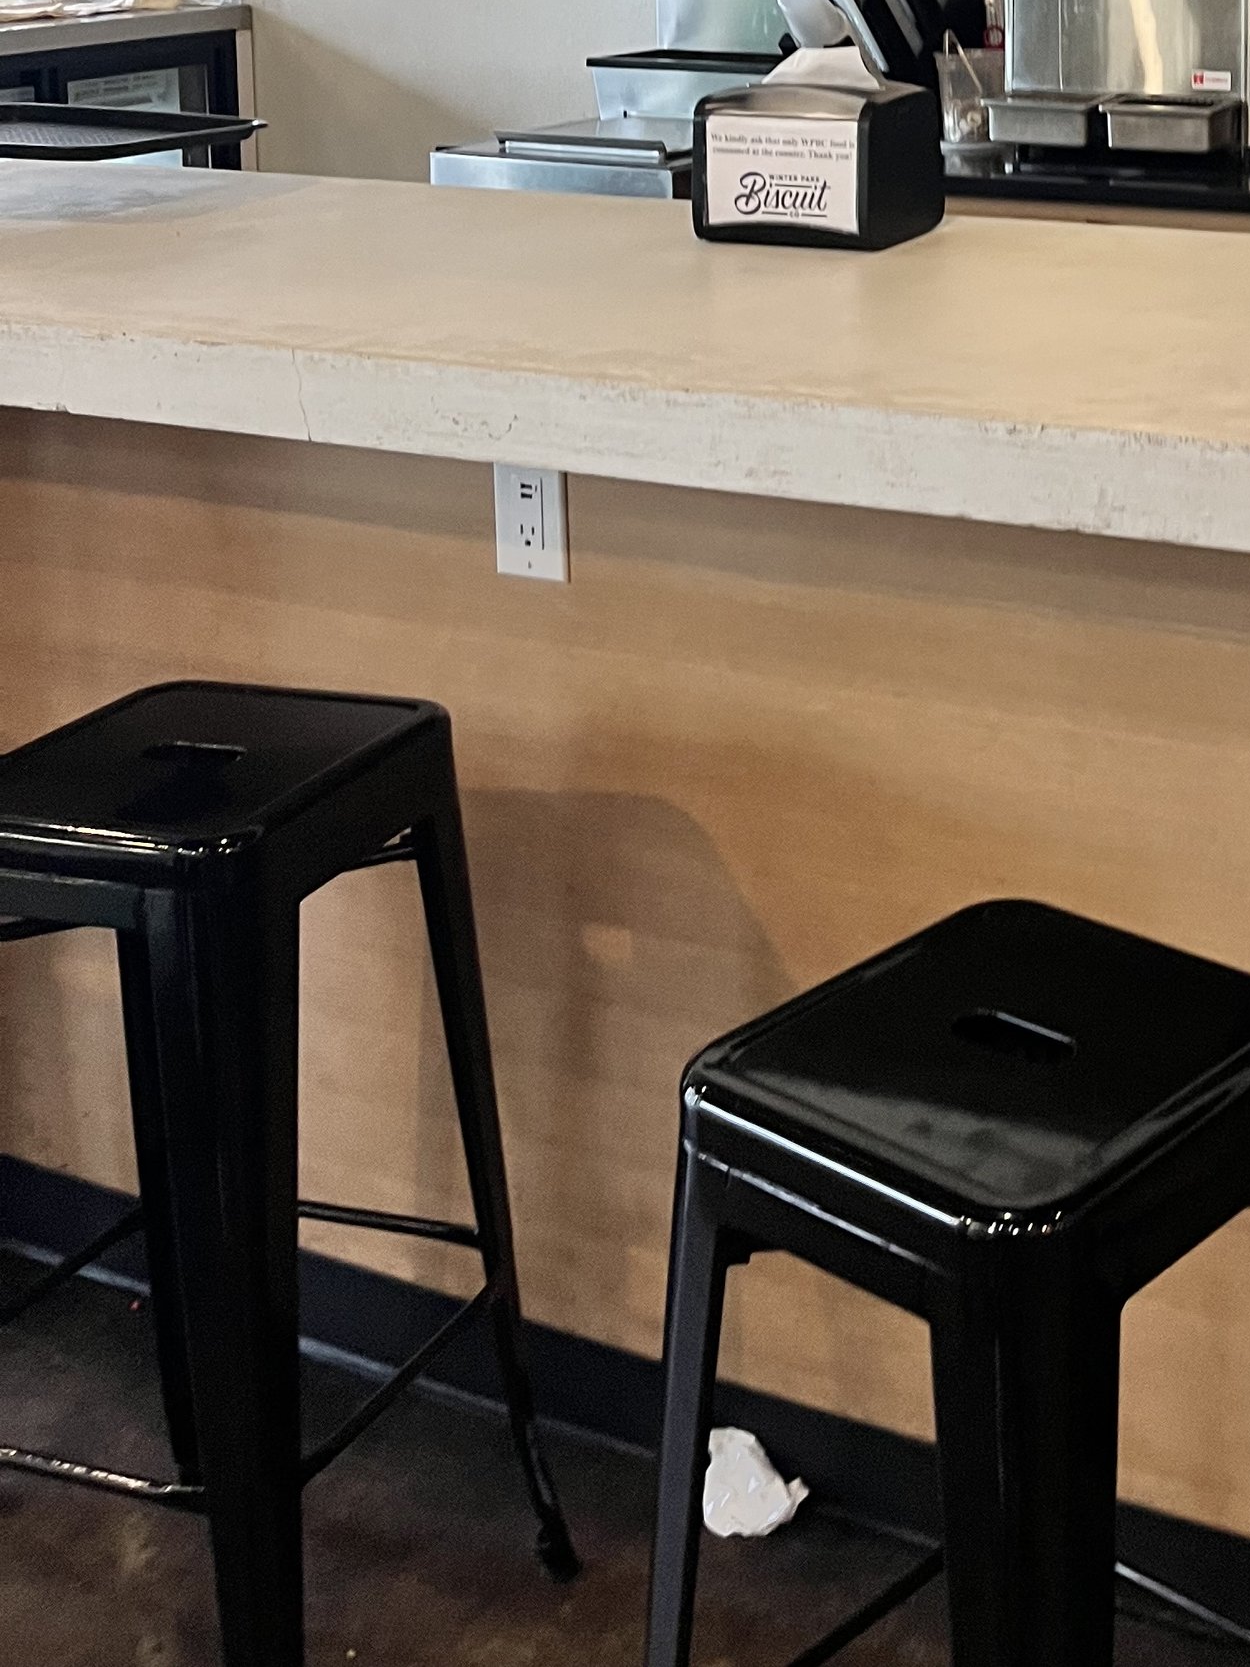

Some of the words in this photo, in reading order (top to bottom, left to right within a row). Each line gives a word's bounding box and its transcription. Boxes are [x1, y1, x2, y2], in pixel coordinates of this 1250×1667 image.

[725, 134, 748, 146] kindly
[808, 150, 833, 159] Thank
[801, 175, 820, 183] PARK
[734, 171, 831, 216] Biscuit
